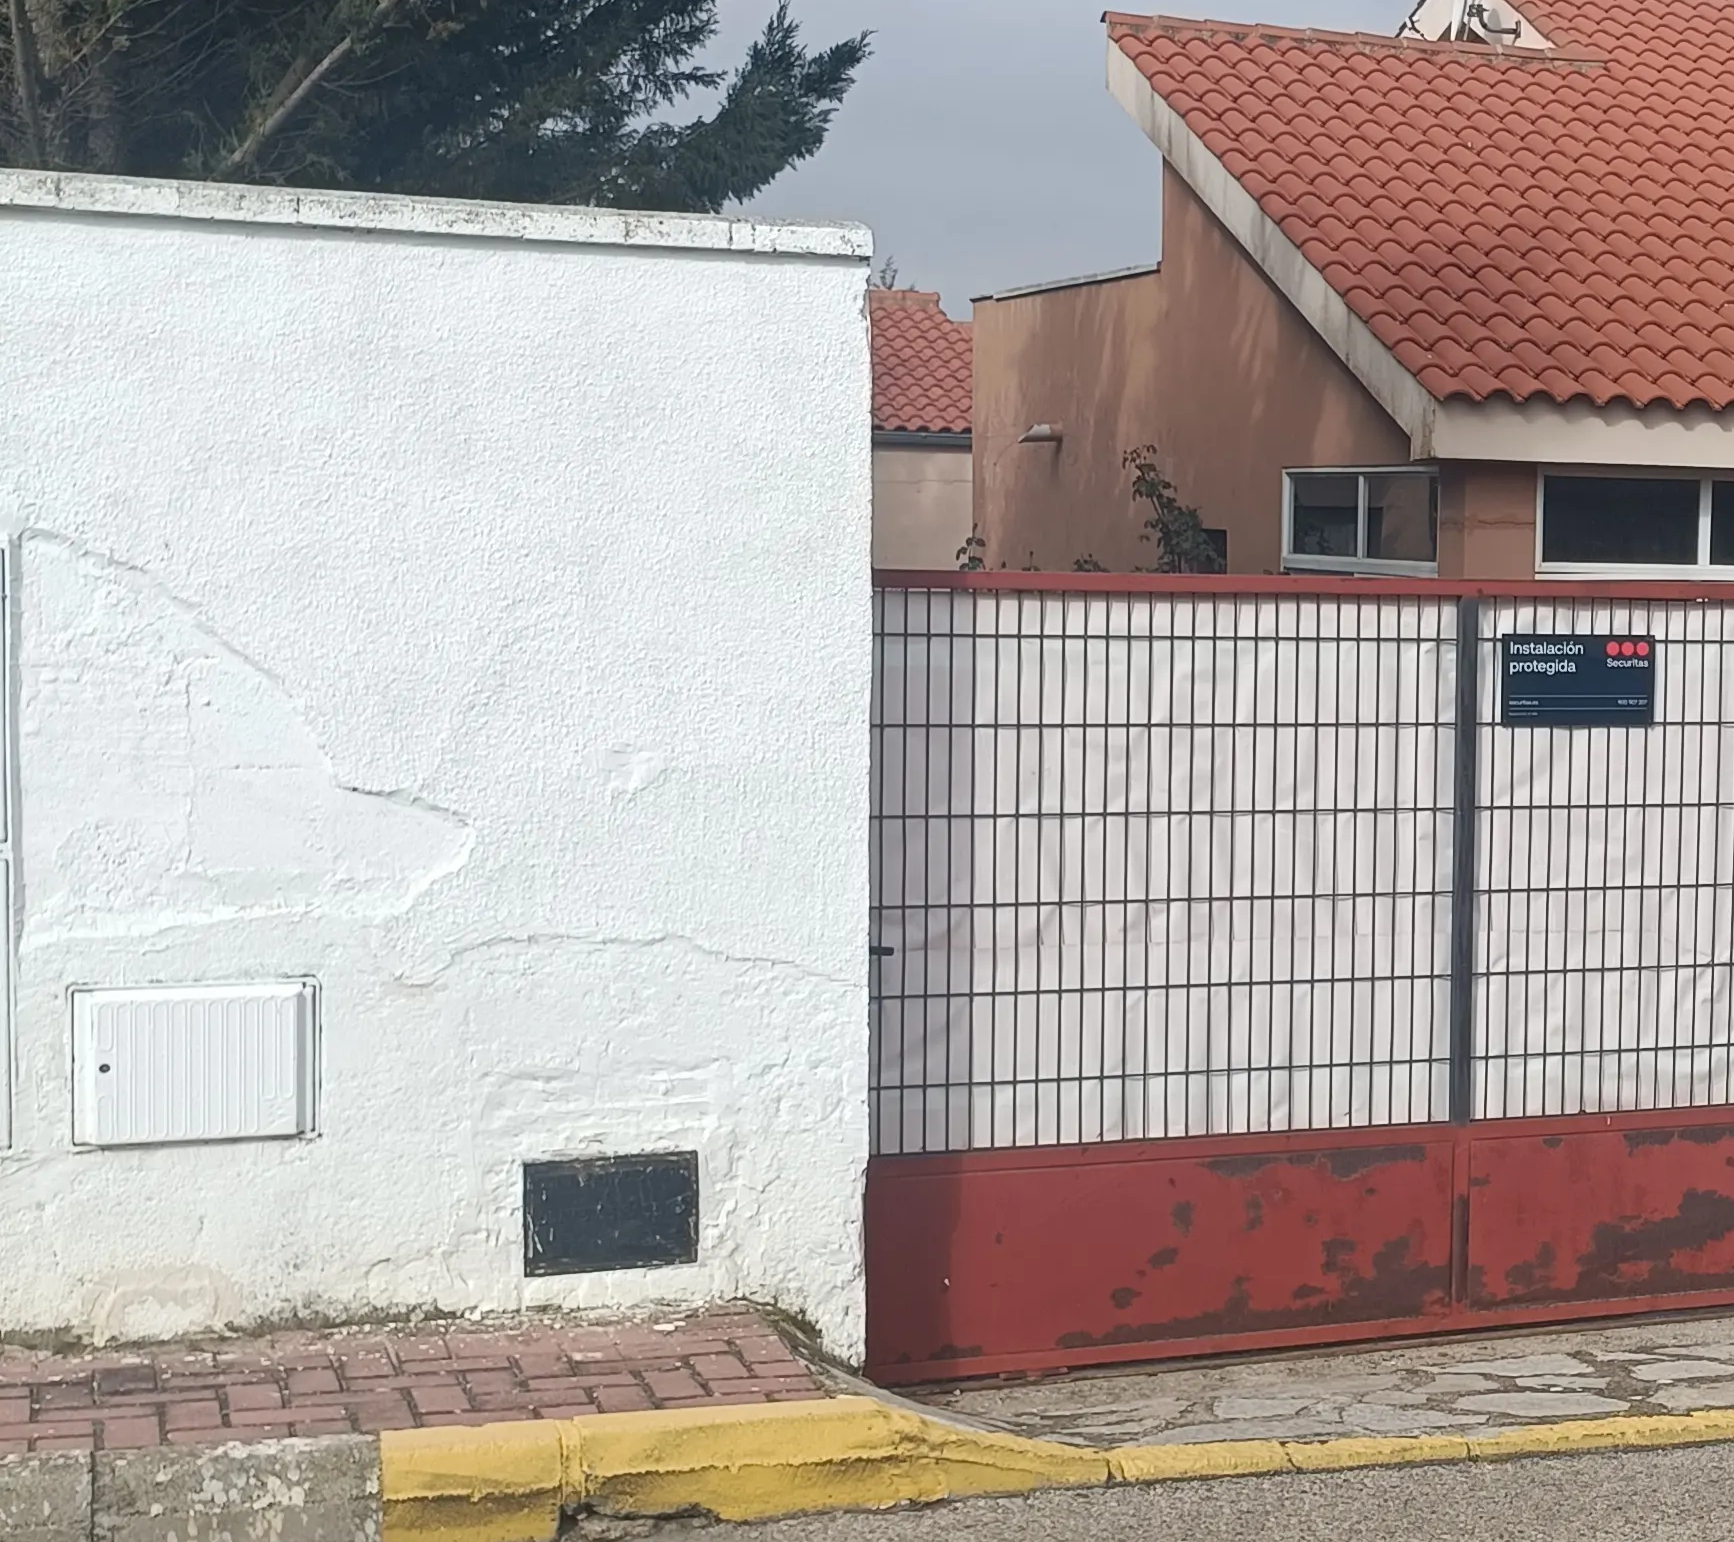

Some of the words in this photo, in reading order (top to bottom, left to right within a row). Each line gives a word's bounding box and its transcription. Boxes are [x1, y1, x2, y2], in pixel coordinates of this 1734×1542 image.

[1509, 641, 1584, 655] Instalación
[1509, 659, 1576, 675] protegida
[1606, 658, 1649, 668] Securitas
